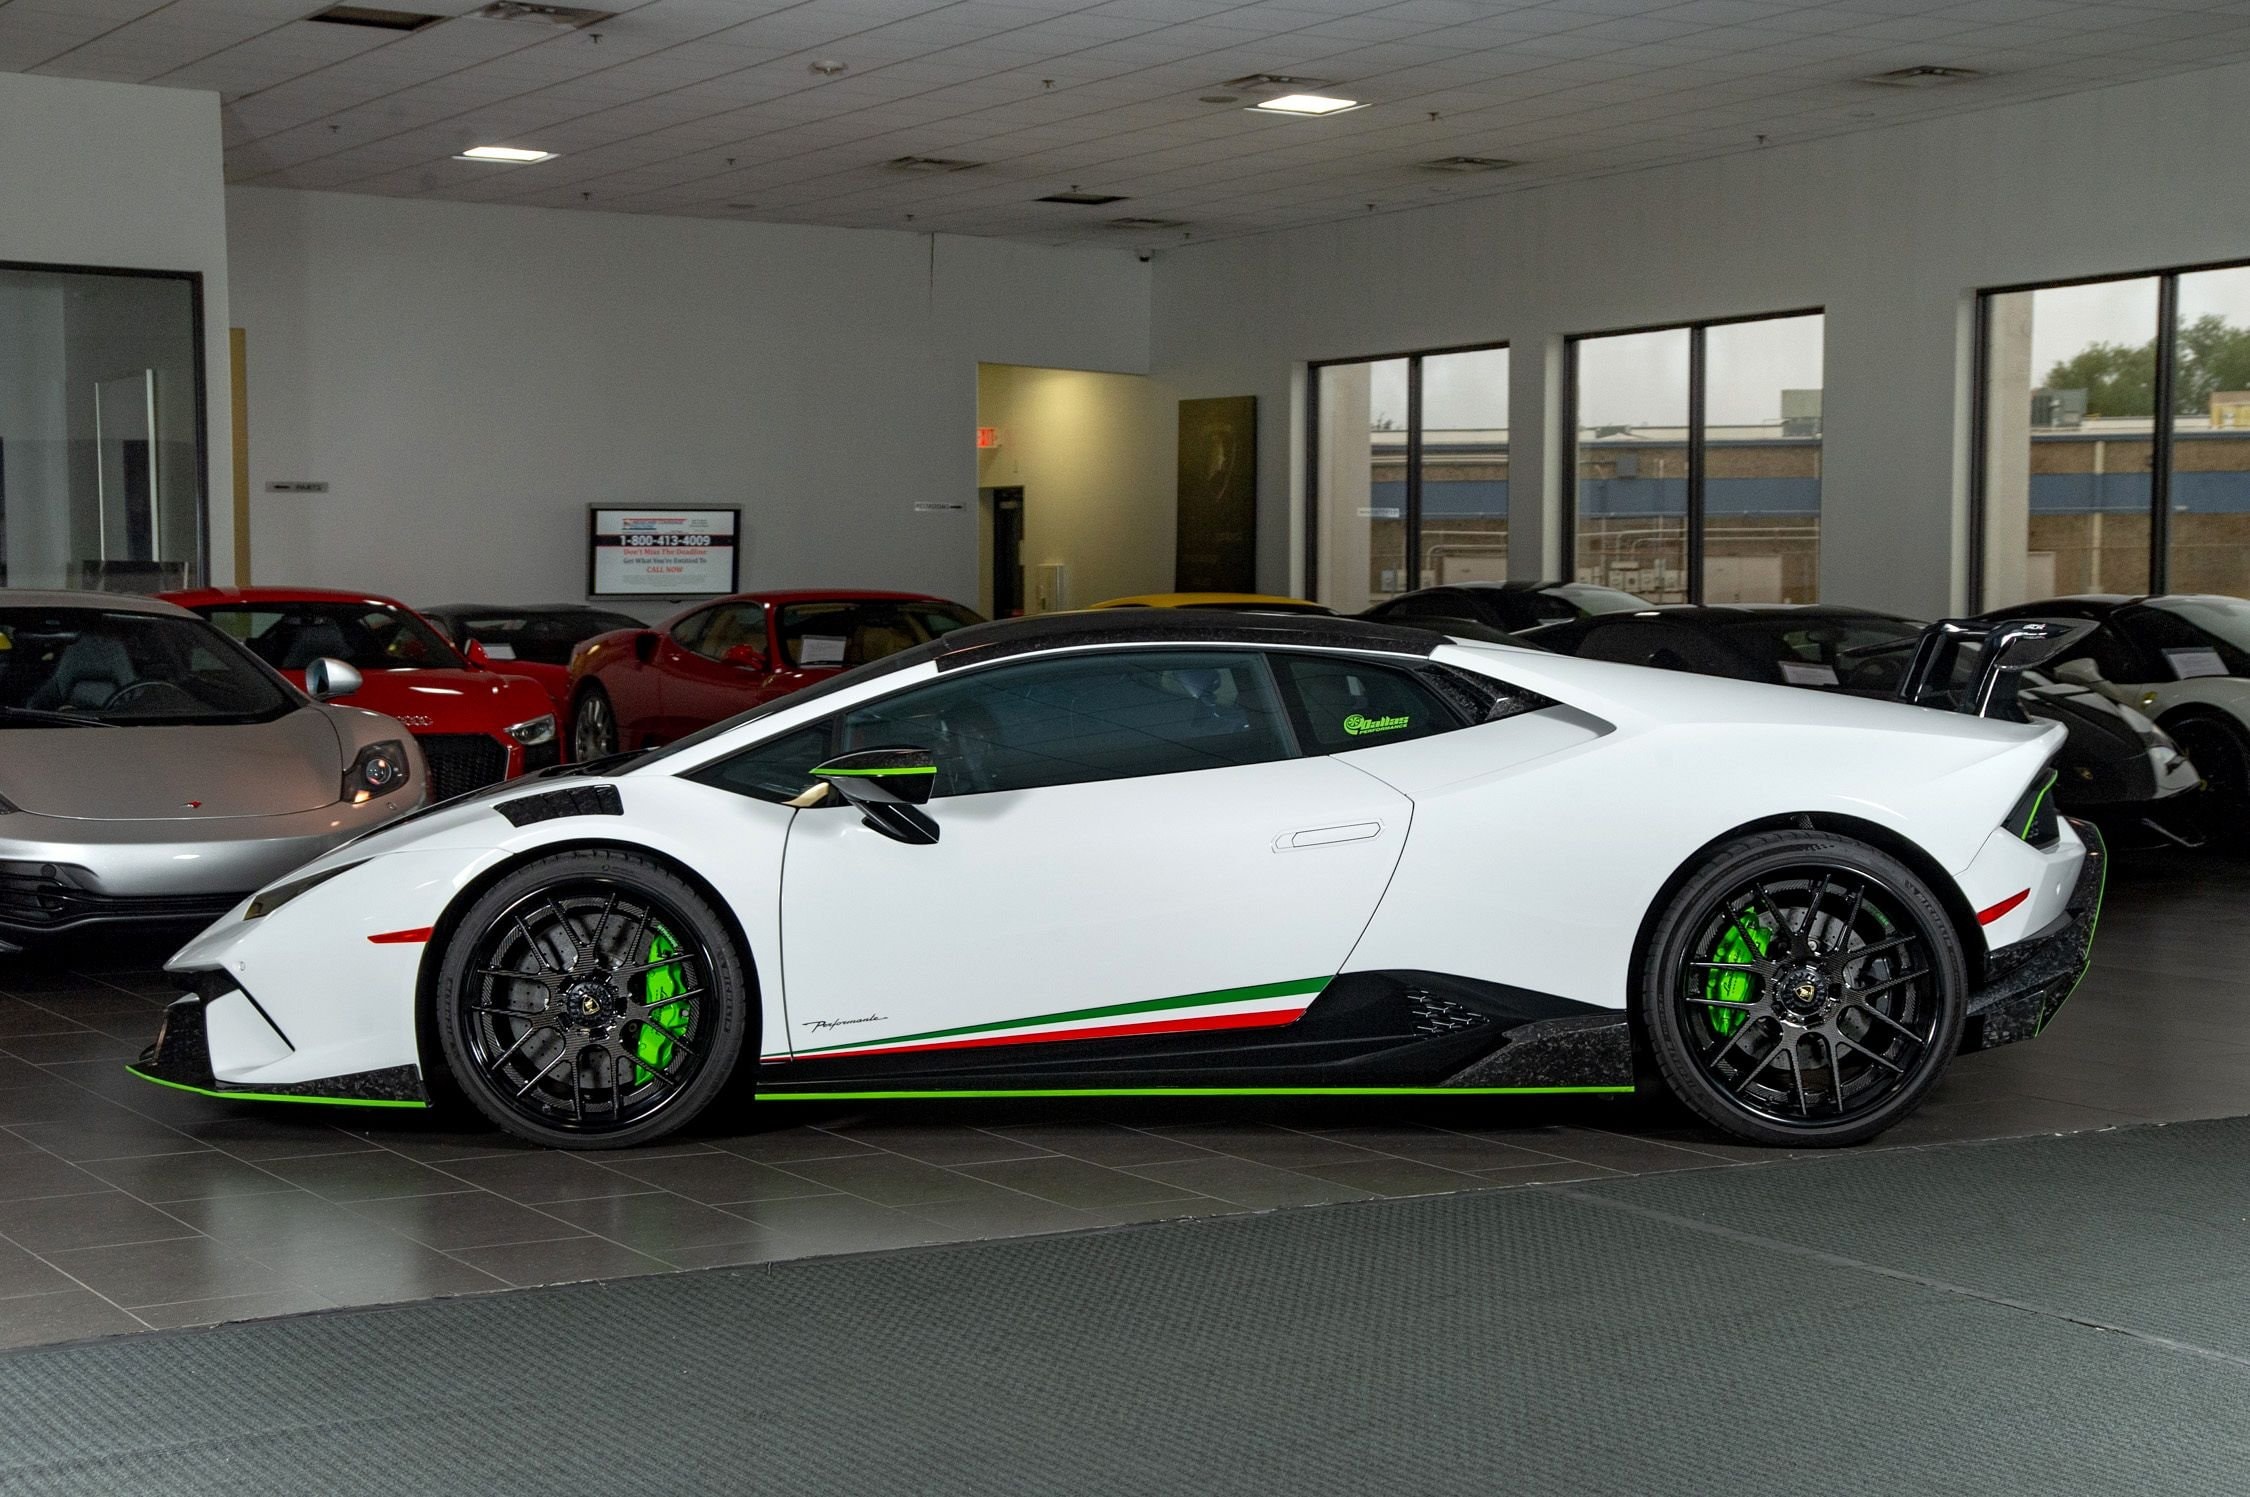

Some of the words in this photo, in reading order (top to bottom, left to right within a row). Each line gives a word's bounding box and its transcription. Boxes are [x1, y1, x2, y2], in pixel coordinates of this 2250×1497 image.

[620, 535, 711, 546] 1-800-413-4009
[623, 548, 643, 556] Don't
[644, 548, 660, 556] Miss
[661, 548, 674, 556] The
[676, 548, 708, 556] Deadline
[1360, 715, 1409, 730] Dallas
[1359, 724, 1408, 735] PERFORMANCE
[802, 1013, 888, 1033] Performante
